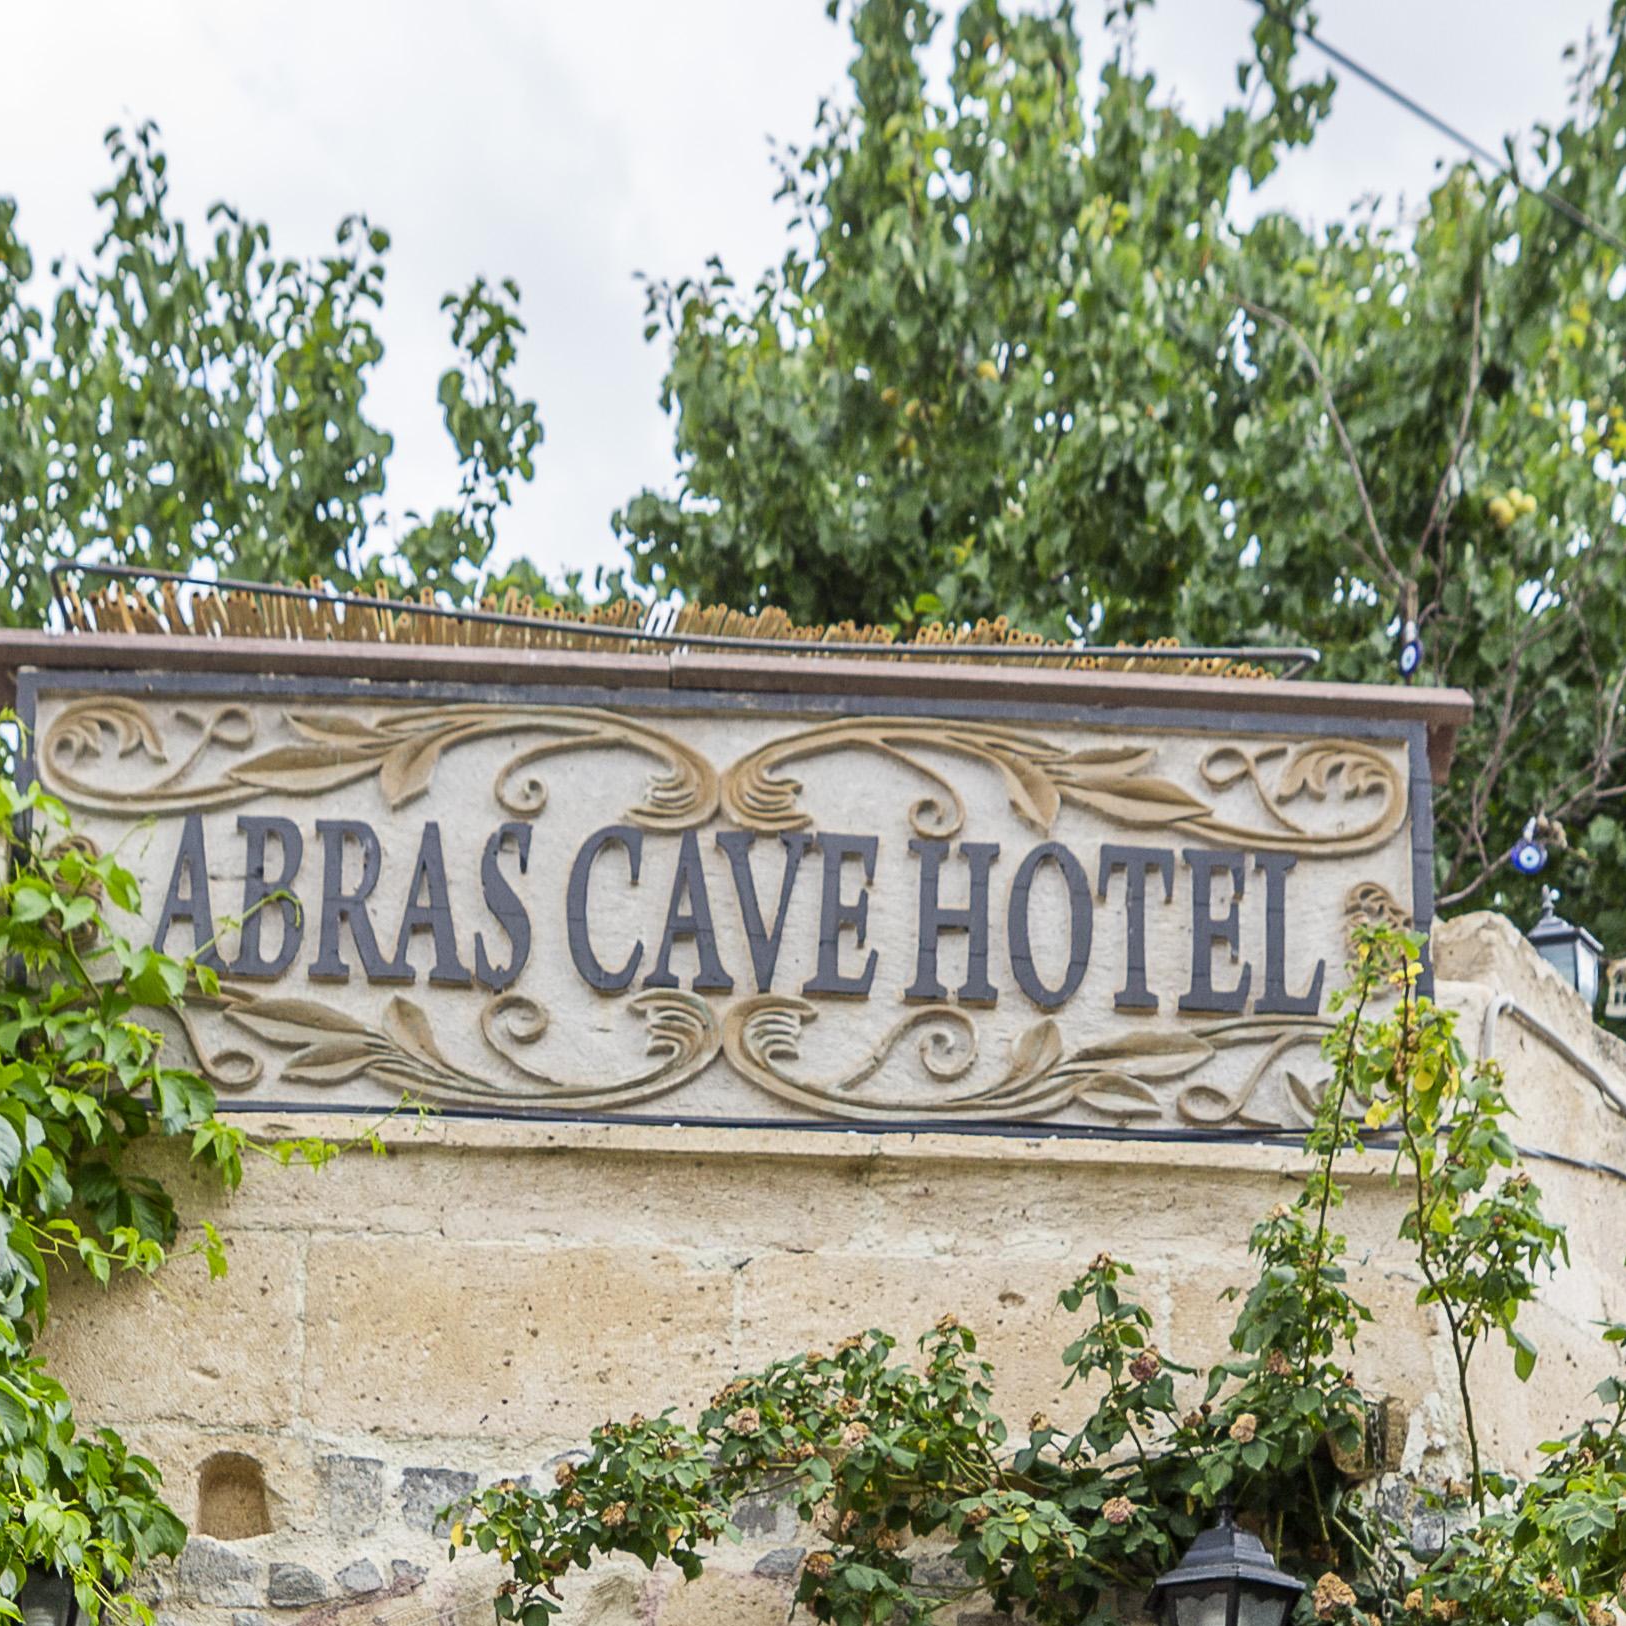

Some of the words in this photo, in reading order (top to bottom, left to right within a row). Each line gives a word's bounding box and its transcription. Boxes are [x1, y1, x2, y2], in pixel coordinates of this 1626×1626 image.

[152, 815, 534, 994] ABRAS
[566, 825, 879, 995] CAVE
[904, 839, 1326, 1015] HOTEL
